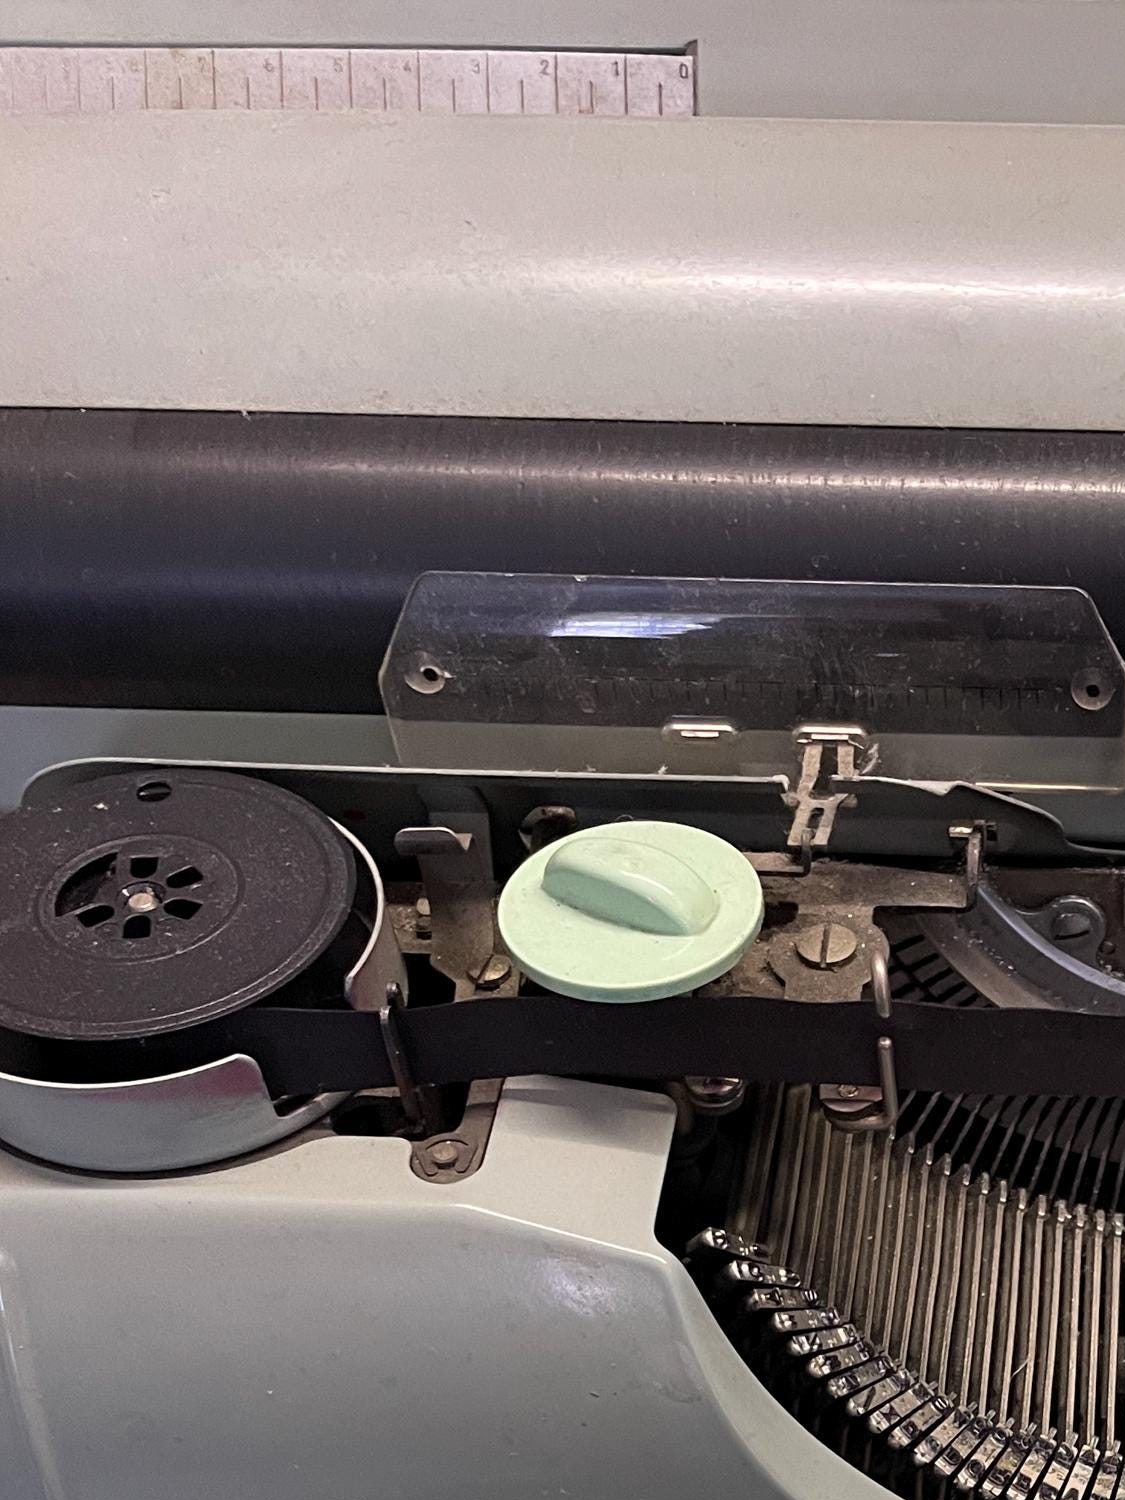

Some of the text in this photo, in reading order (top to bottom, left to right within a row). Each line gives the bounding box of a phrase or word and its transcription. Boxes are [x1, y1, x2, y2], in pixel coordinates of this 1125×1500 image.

[472, 58, 480, 74] 3
[539, 60, 548, 76] 2
[611, 62, 619, 77] 1
[678, 63, 688, 80] 0
